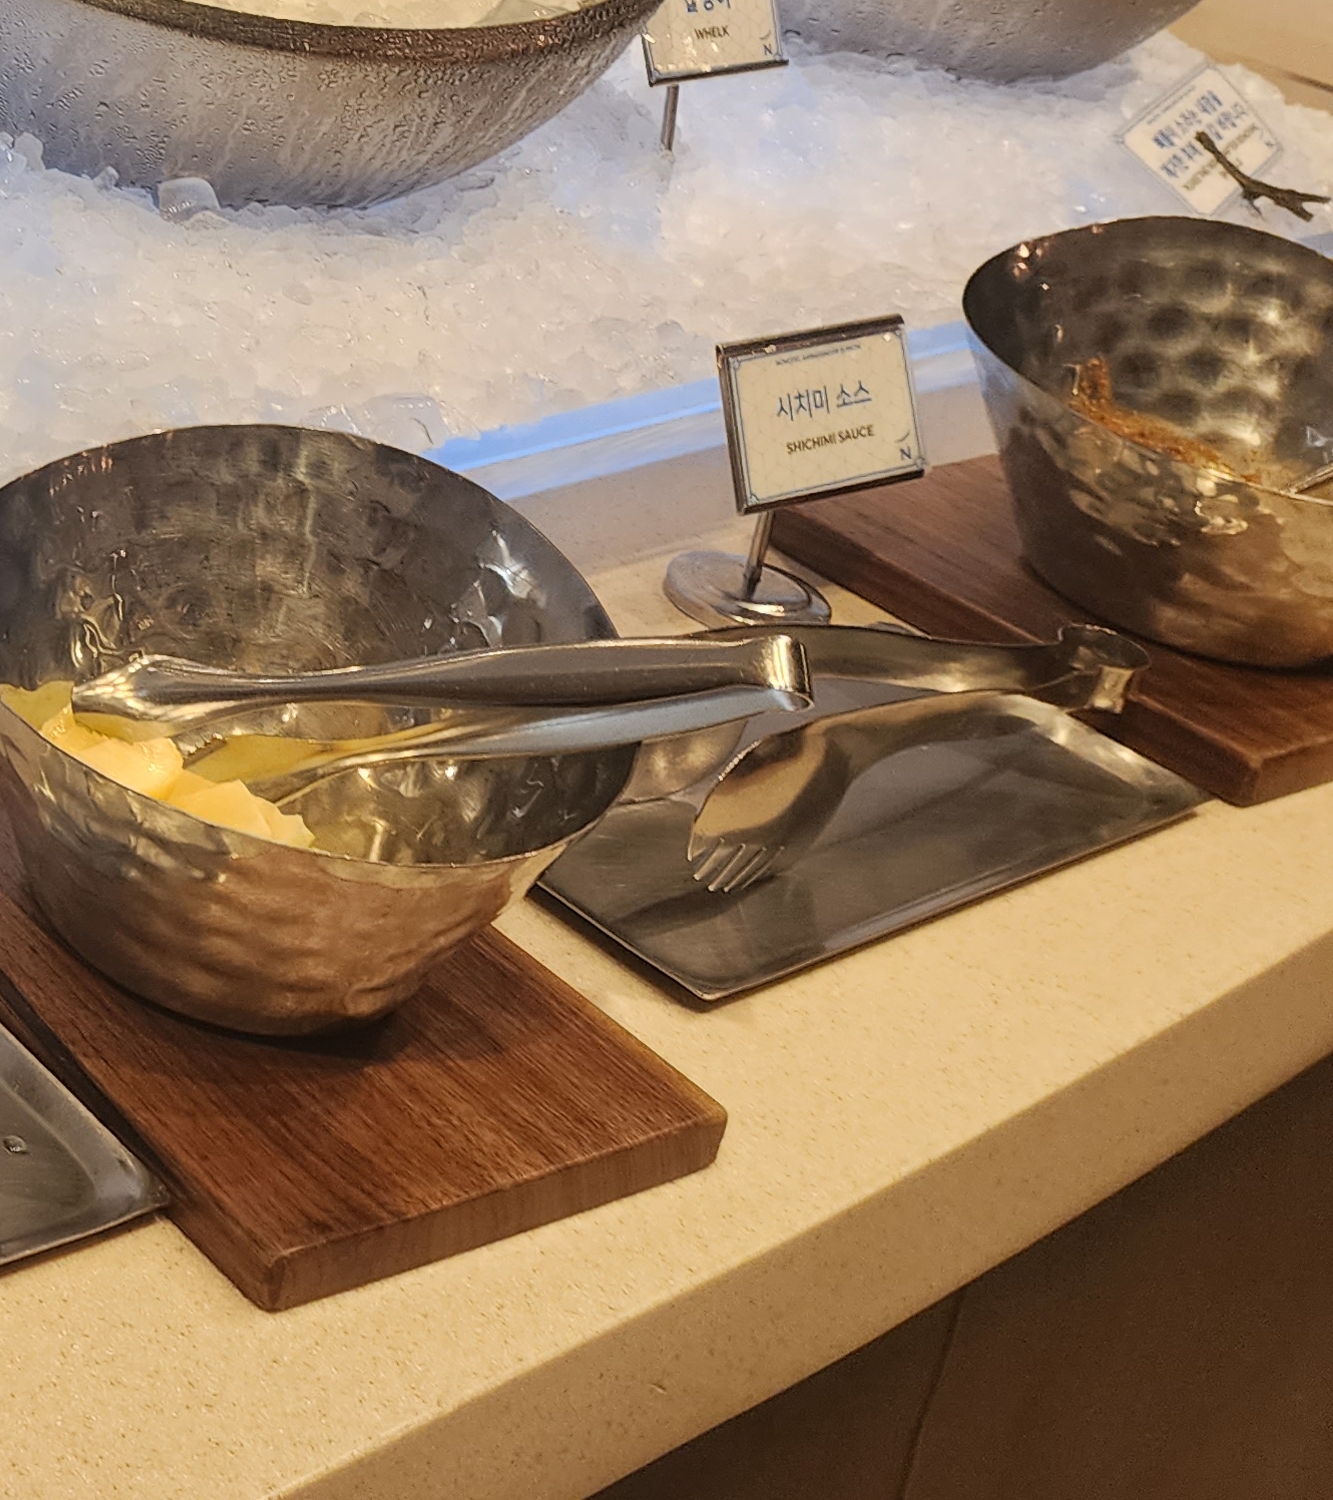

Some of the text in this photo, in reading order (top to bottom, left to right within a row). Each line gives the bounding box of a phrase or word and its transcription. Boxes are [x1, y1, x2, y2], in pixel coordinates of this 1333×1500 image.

[776, 380, 872, 421] 시치미 소스
[786, 424, 876, 455] SHICHIMI SAUCE
